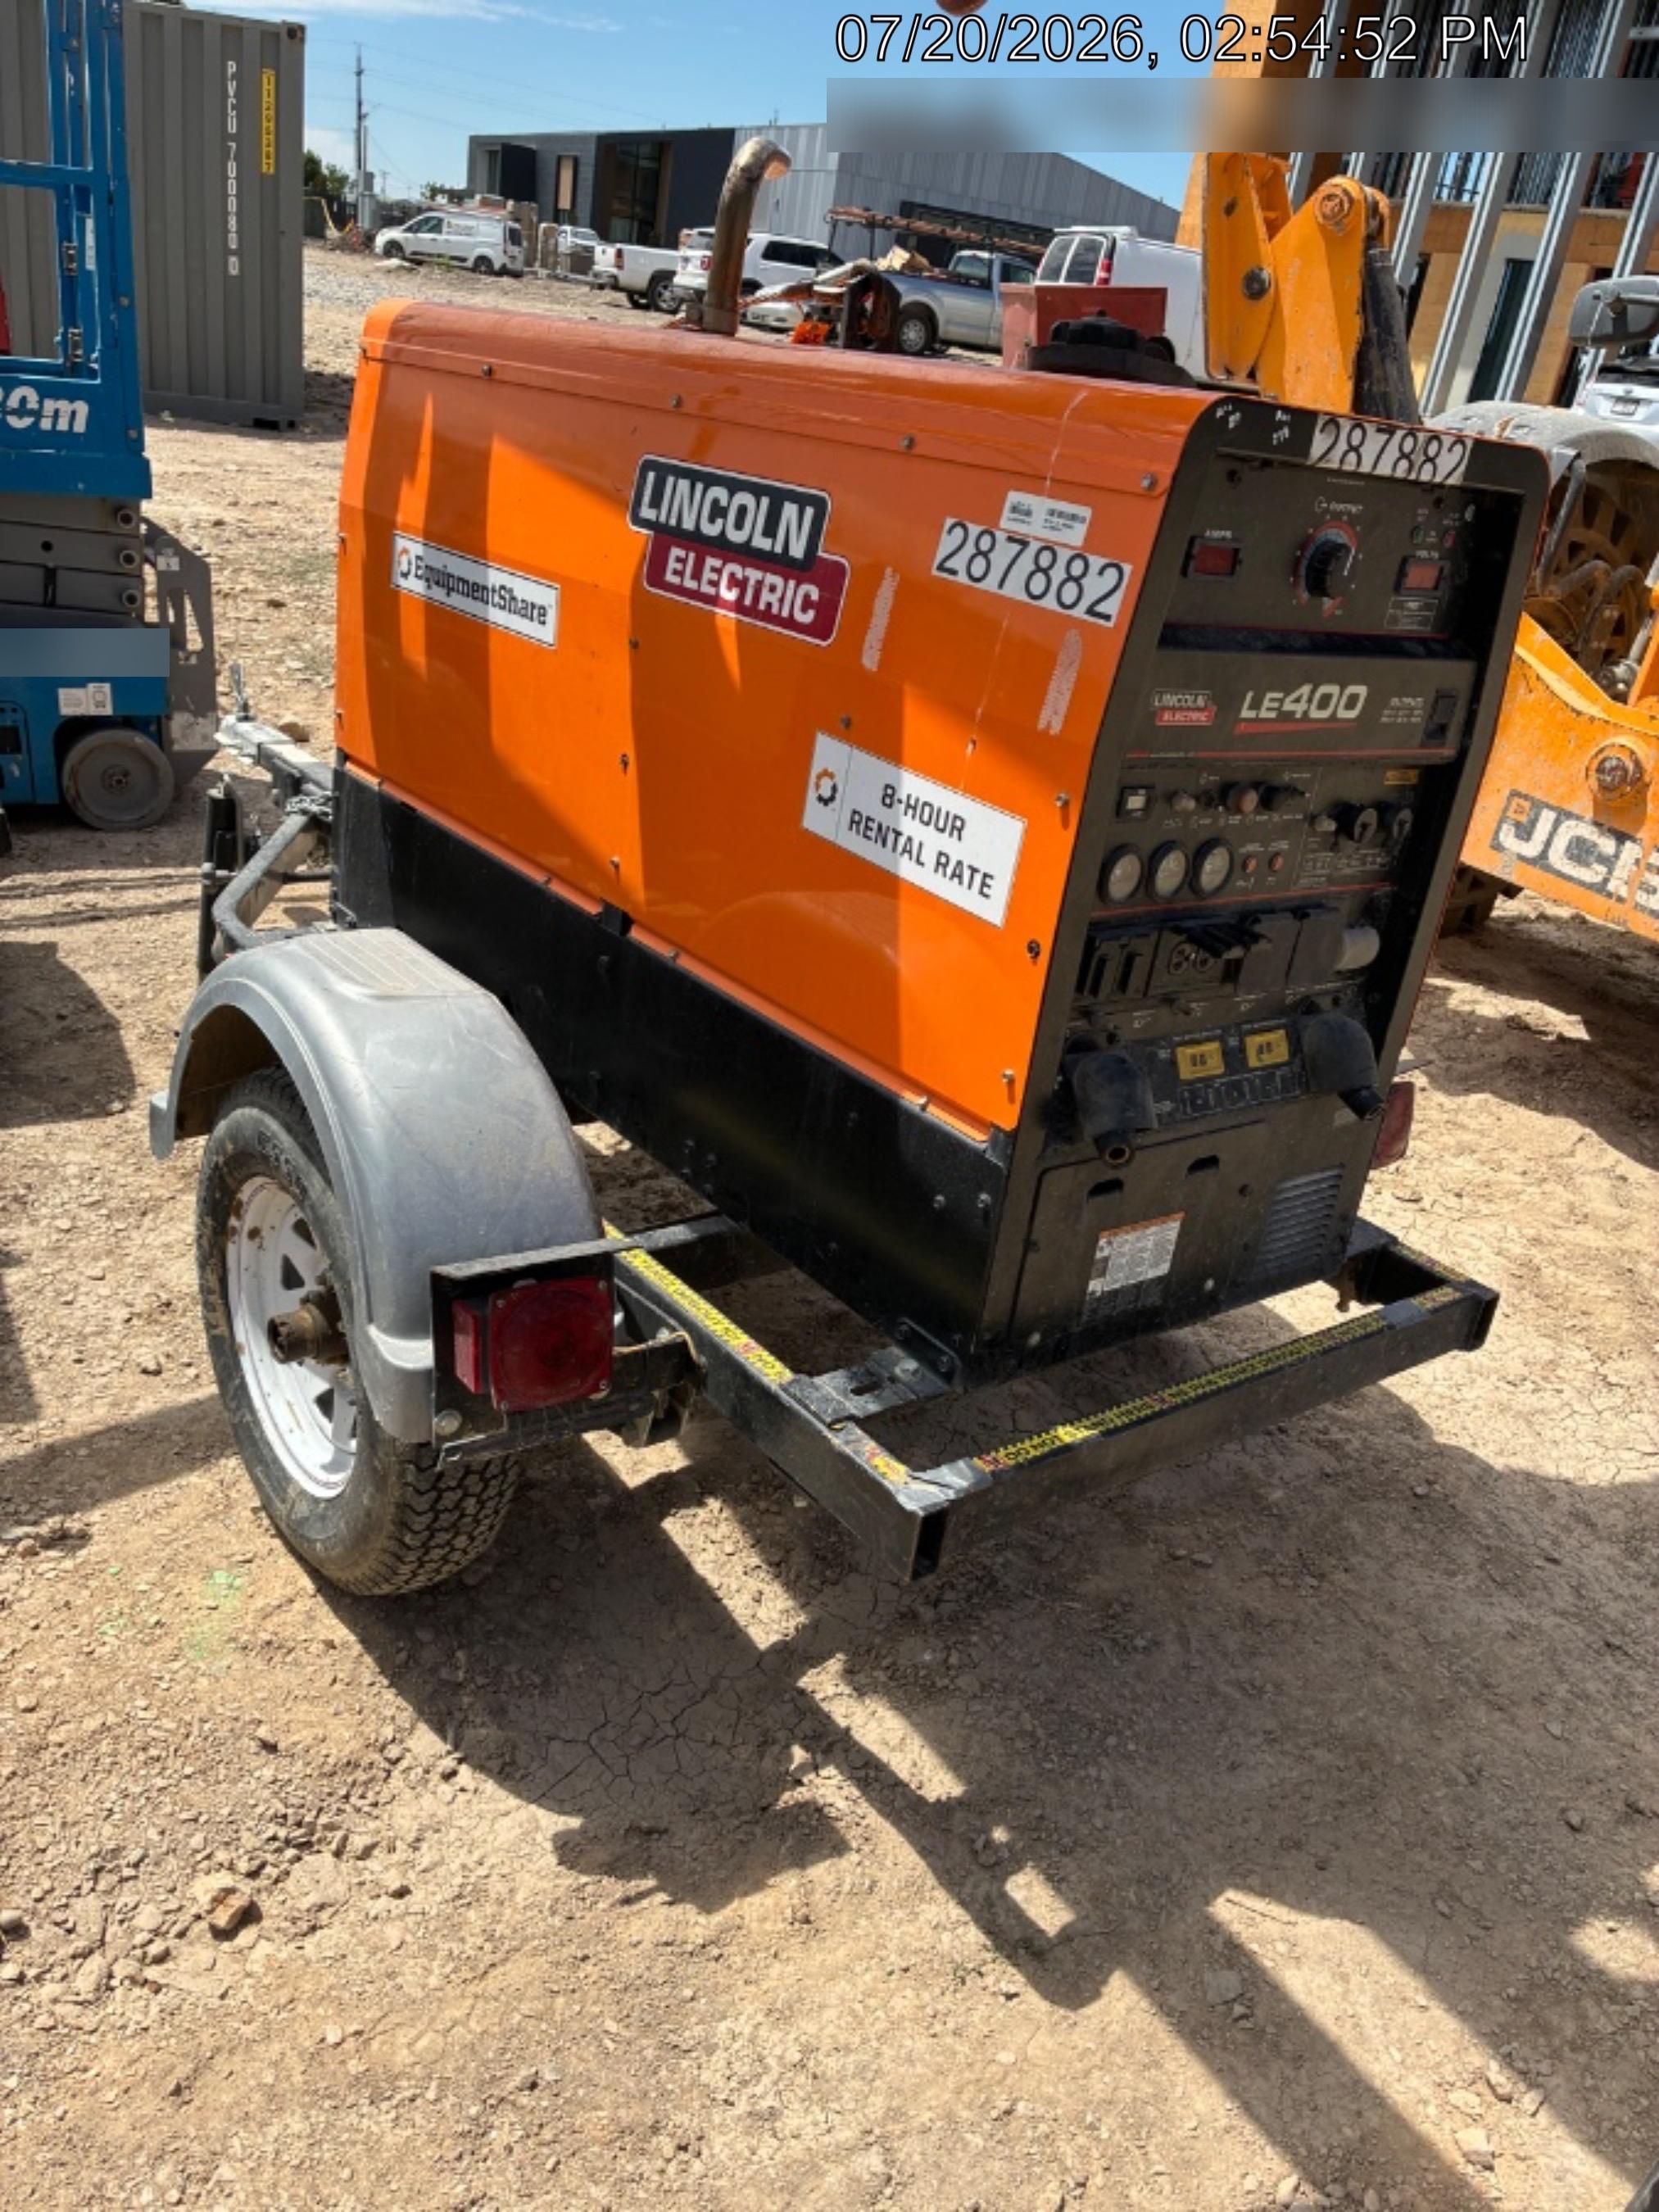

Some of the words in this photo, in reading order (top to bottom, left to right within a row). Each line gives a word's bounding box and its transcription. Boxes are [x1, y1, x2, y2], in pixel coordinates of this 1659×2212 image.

[227, 61, 238, 134] PVCU
[1312, 416, 1467, 485] 287882
[638, 471, 814, 560] LINCOLN
[415, 555, 548, 626] EquipmentShare
[664, 546, 820, 624] ELECTRIC
[936, 520, 1126, 623] 287882
[1238, 682, 1367, 719] LE400
[881, 783, 966, 842] 8-HOUR
[848, 808, 926, 868] RENTAL
[934, 850, 995, 900] RATE
